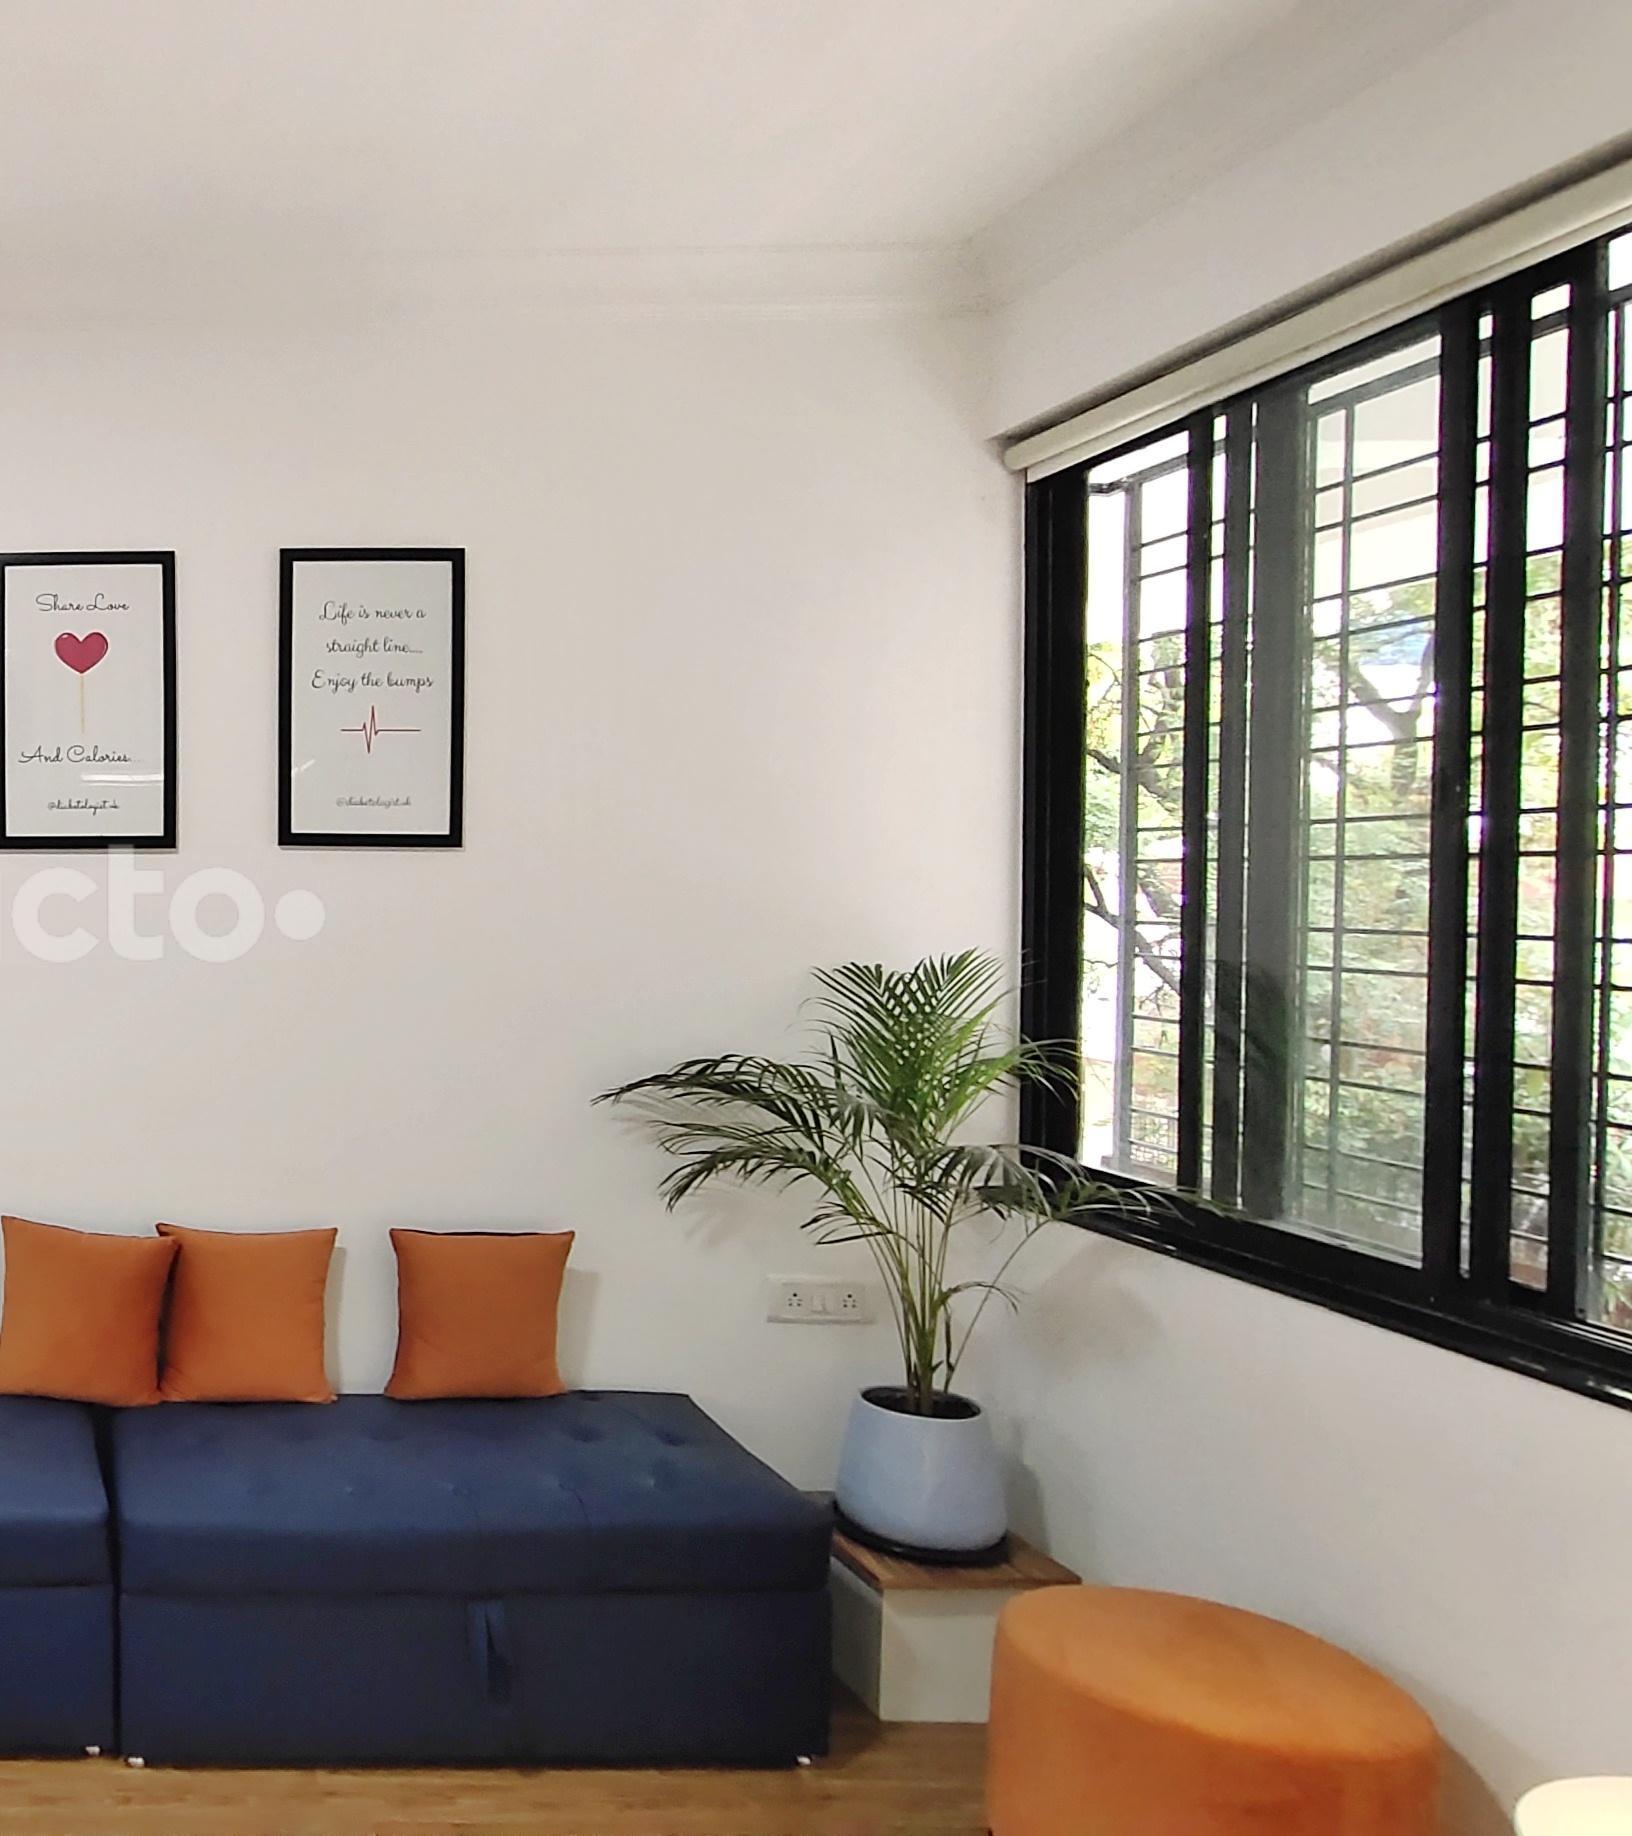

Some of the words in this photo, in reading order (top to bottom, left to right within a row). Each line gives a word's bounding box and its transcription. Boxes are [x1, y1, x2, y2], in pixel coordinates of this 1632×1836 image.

[35, 593, 85, 612] Share
[85, 593, 130, 612] Love
[319, 600, 354, 626] Life
[358, 604, 370, 620] is
[375, 609, 413, 620] never
[416, 609, 427, 620] a
[326, 638, 379, 658] straight
[311, 669, 358, 694] Enjoy
[361, 672, 384, 688] the
[386, 672, 434, 693] bumps
[18, 745, 64, 764] And
